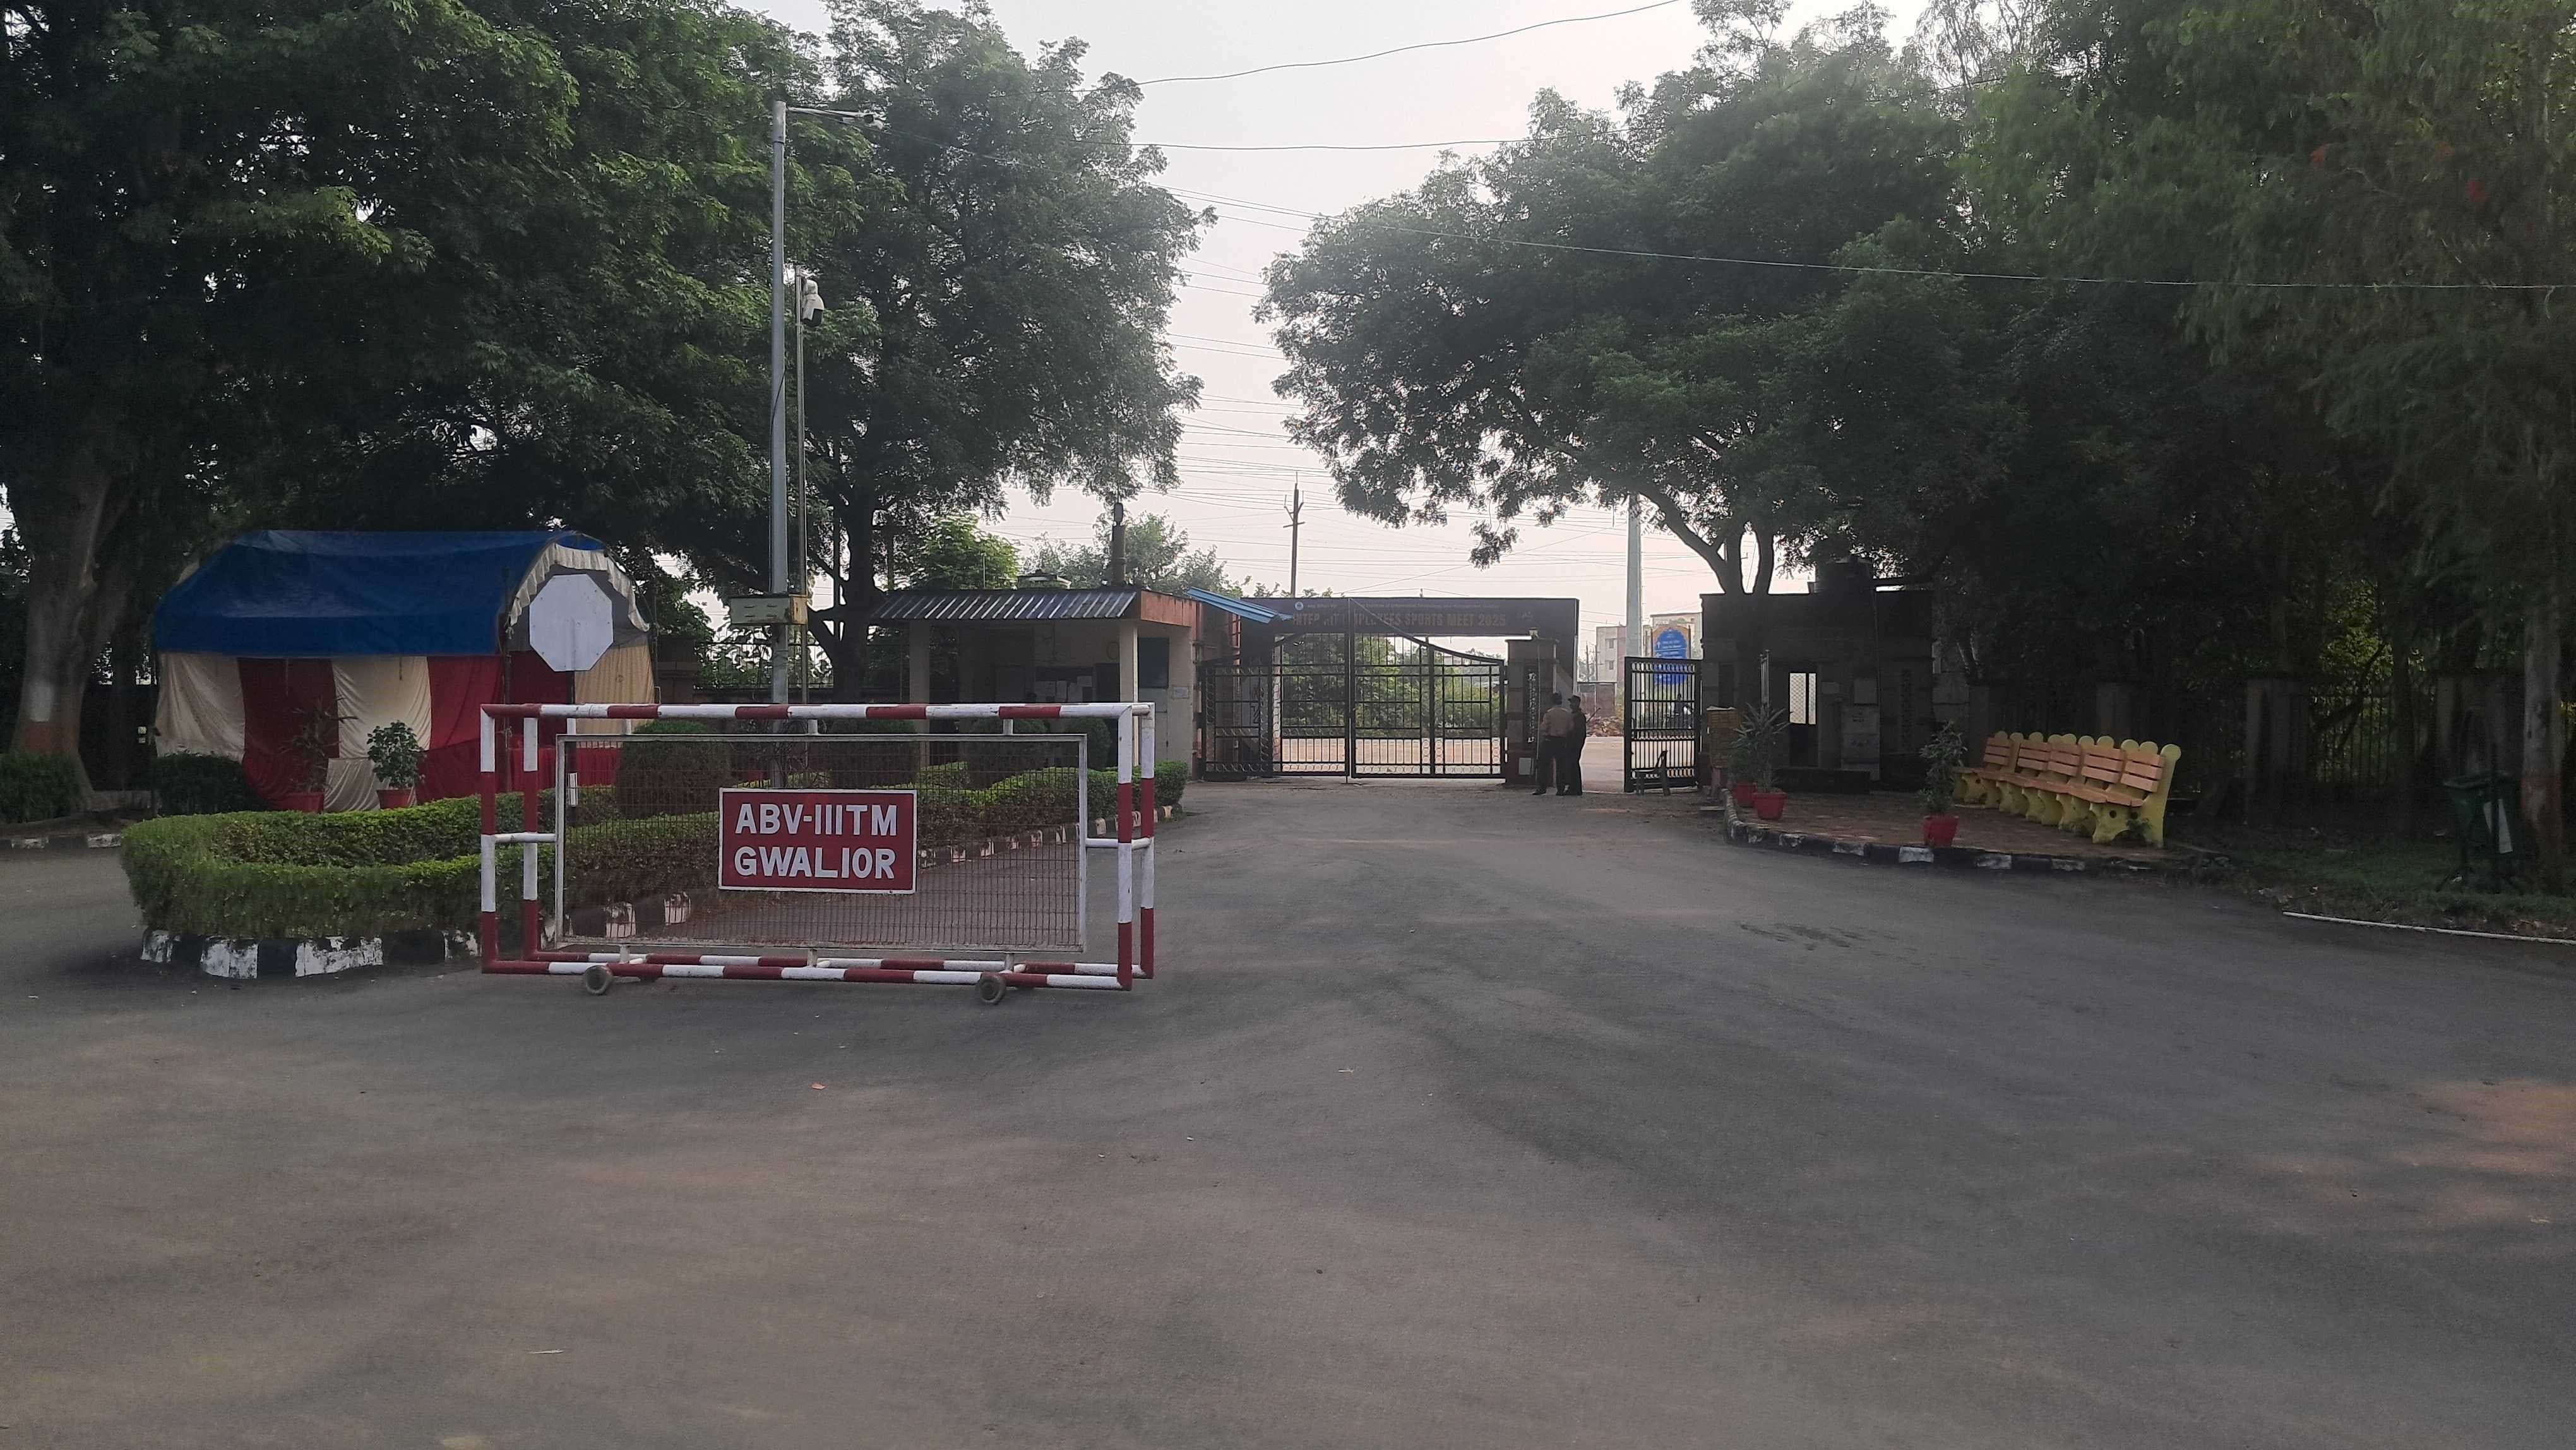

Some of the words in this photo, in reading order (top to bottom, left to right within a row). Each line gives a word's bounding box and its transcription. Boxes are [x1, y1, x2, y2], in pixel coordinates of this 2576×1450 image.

[1405, 613, 1443, 626] SPORTS
[1446, 613, 1475, 626] MEET
[735, 804, 897, 836] ABV-IIITM
[734, 846, 896, 879] GWALIOR
